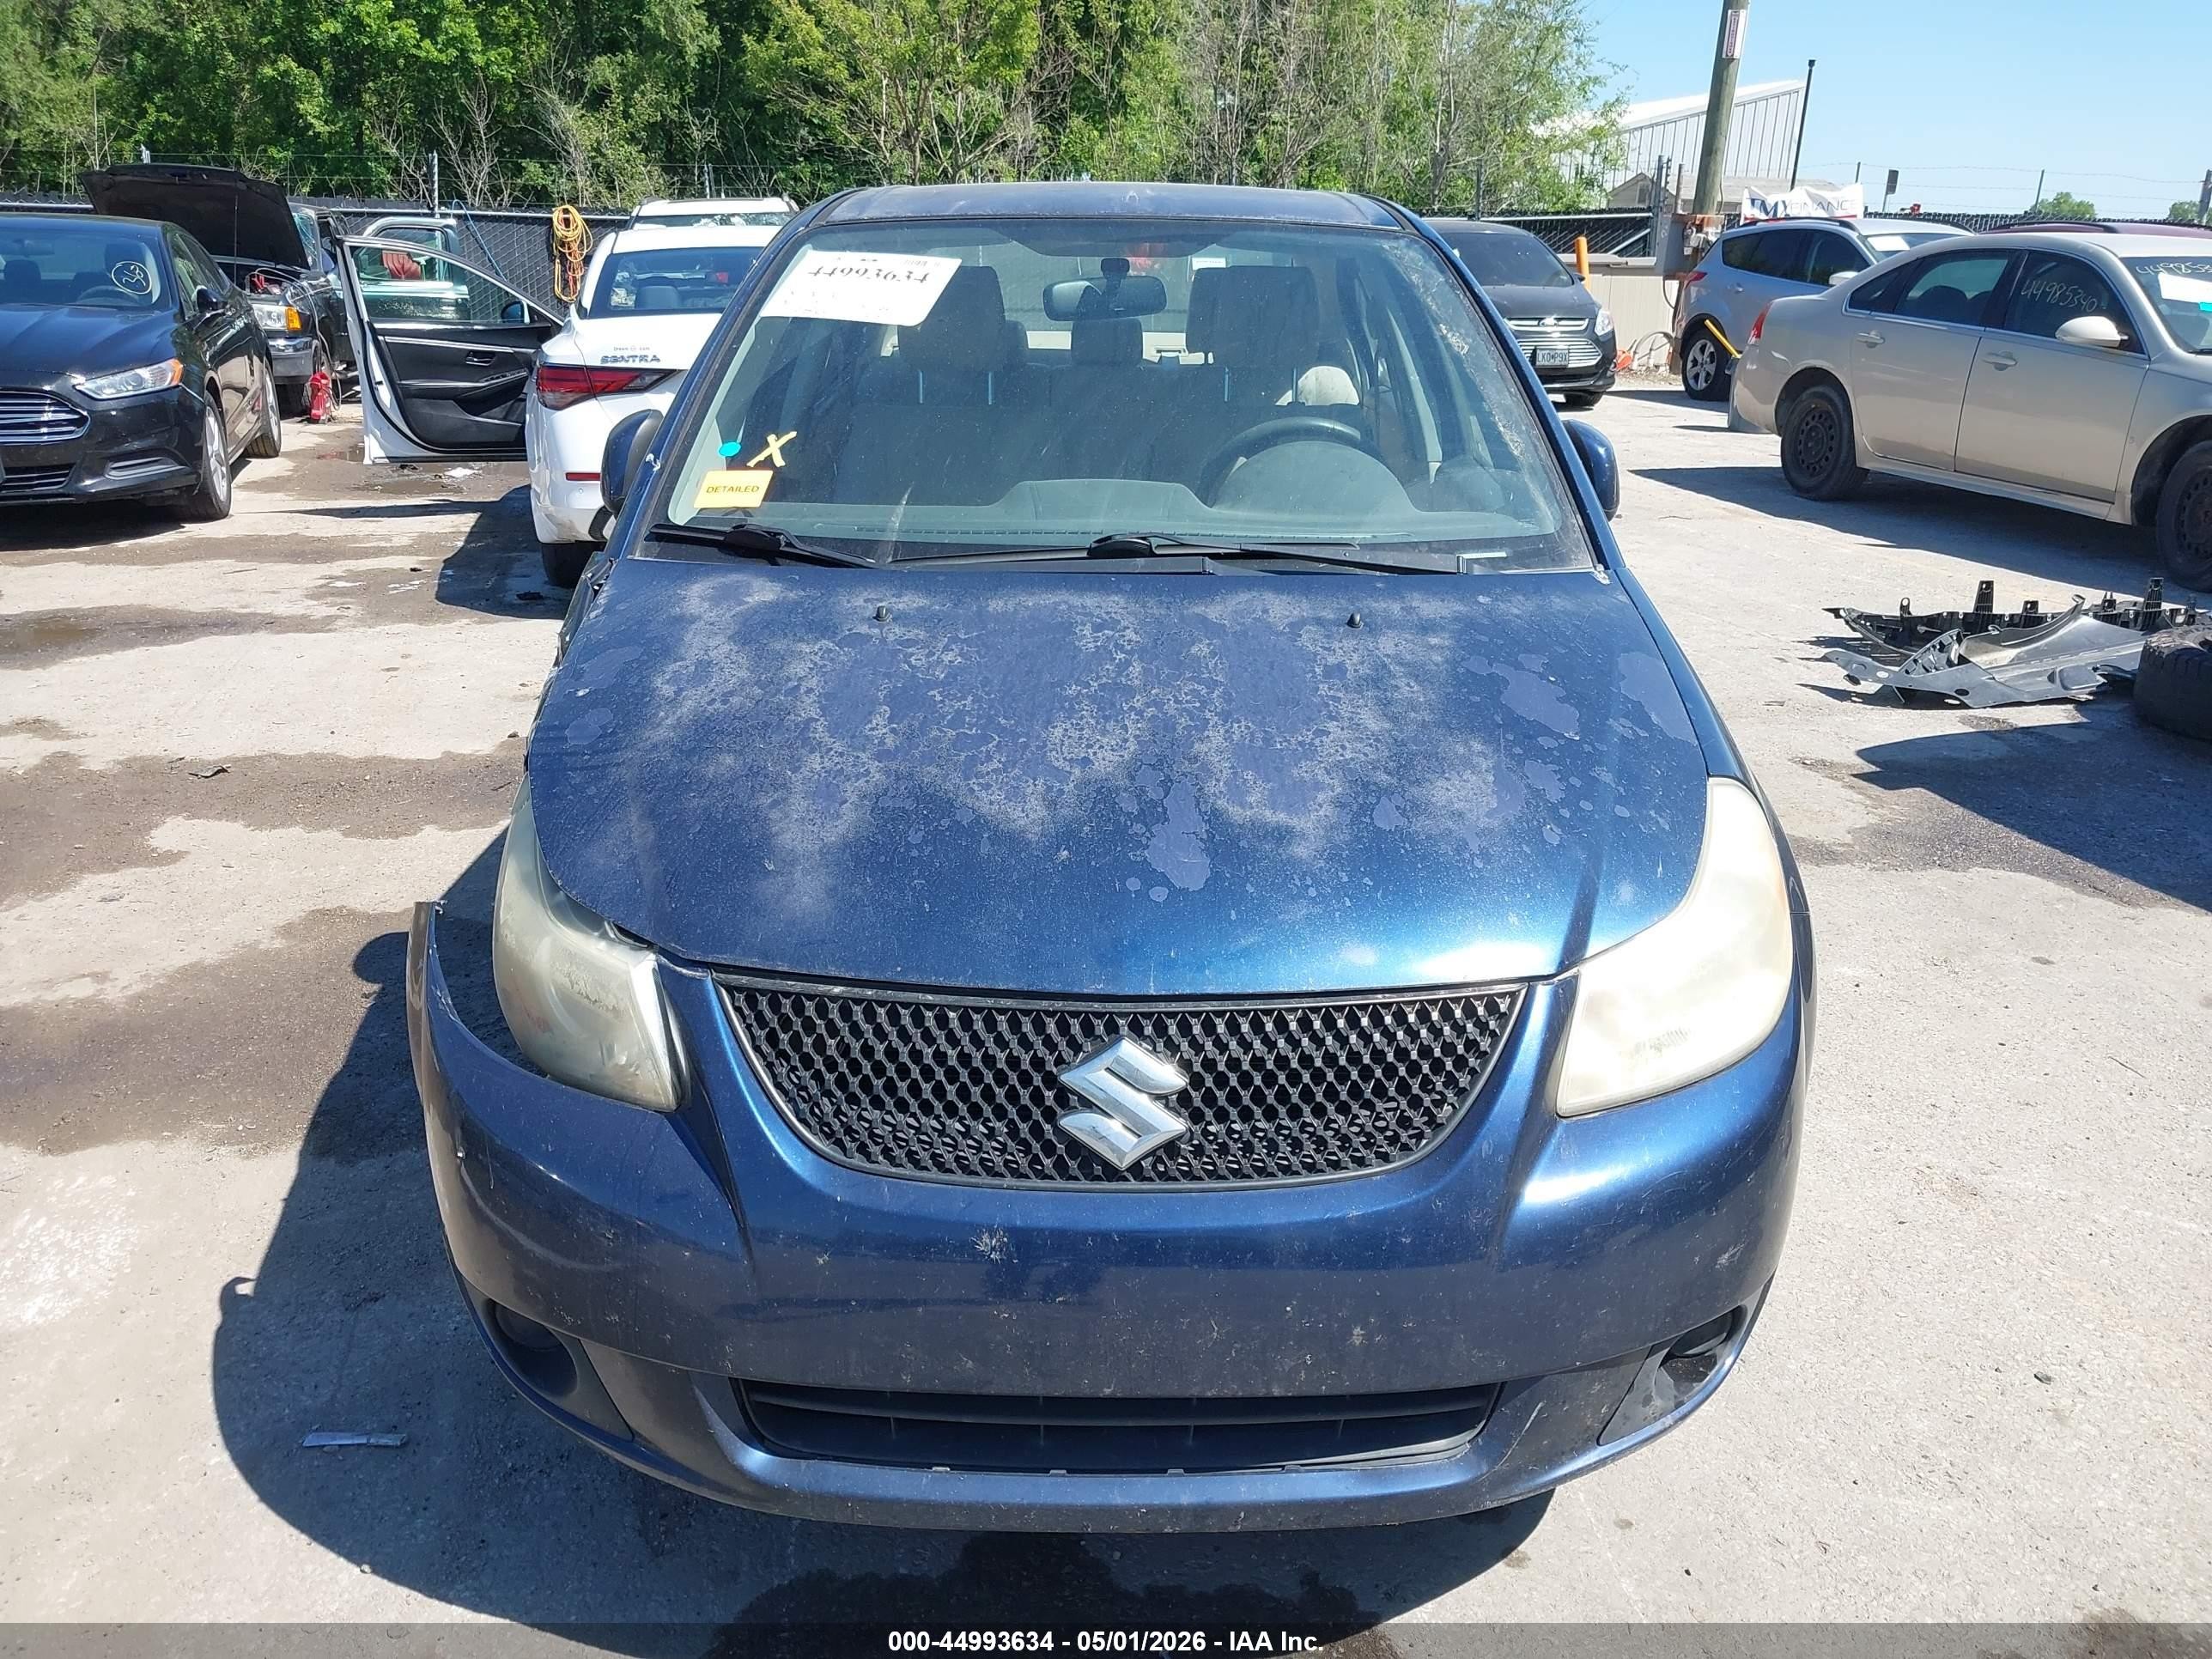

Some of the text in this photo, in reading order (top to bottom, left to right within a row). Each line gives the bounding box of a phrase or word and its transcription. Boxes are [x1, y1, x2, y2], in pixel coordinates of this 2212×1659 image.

[2021, 279, 2098, 313] 44985340
[600, 354, 661, 365] SENTRA
[706, 485, 760, 494] DETAILED
